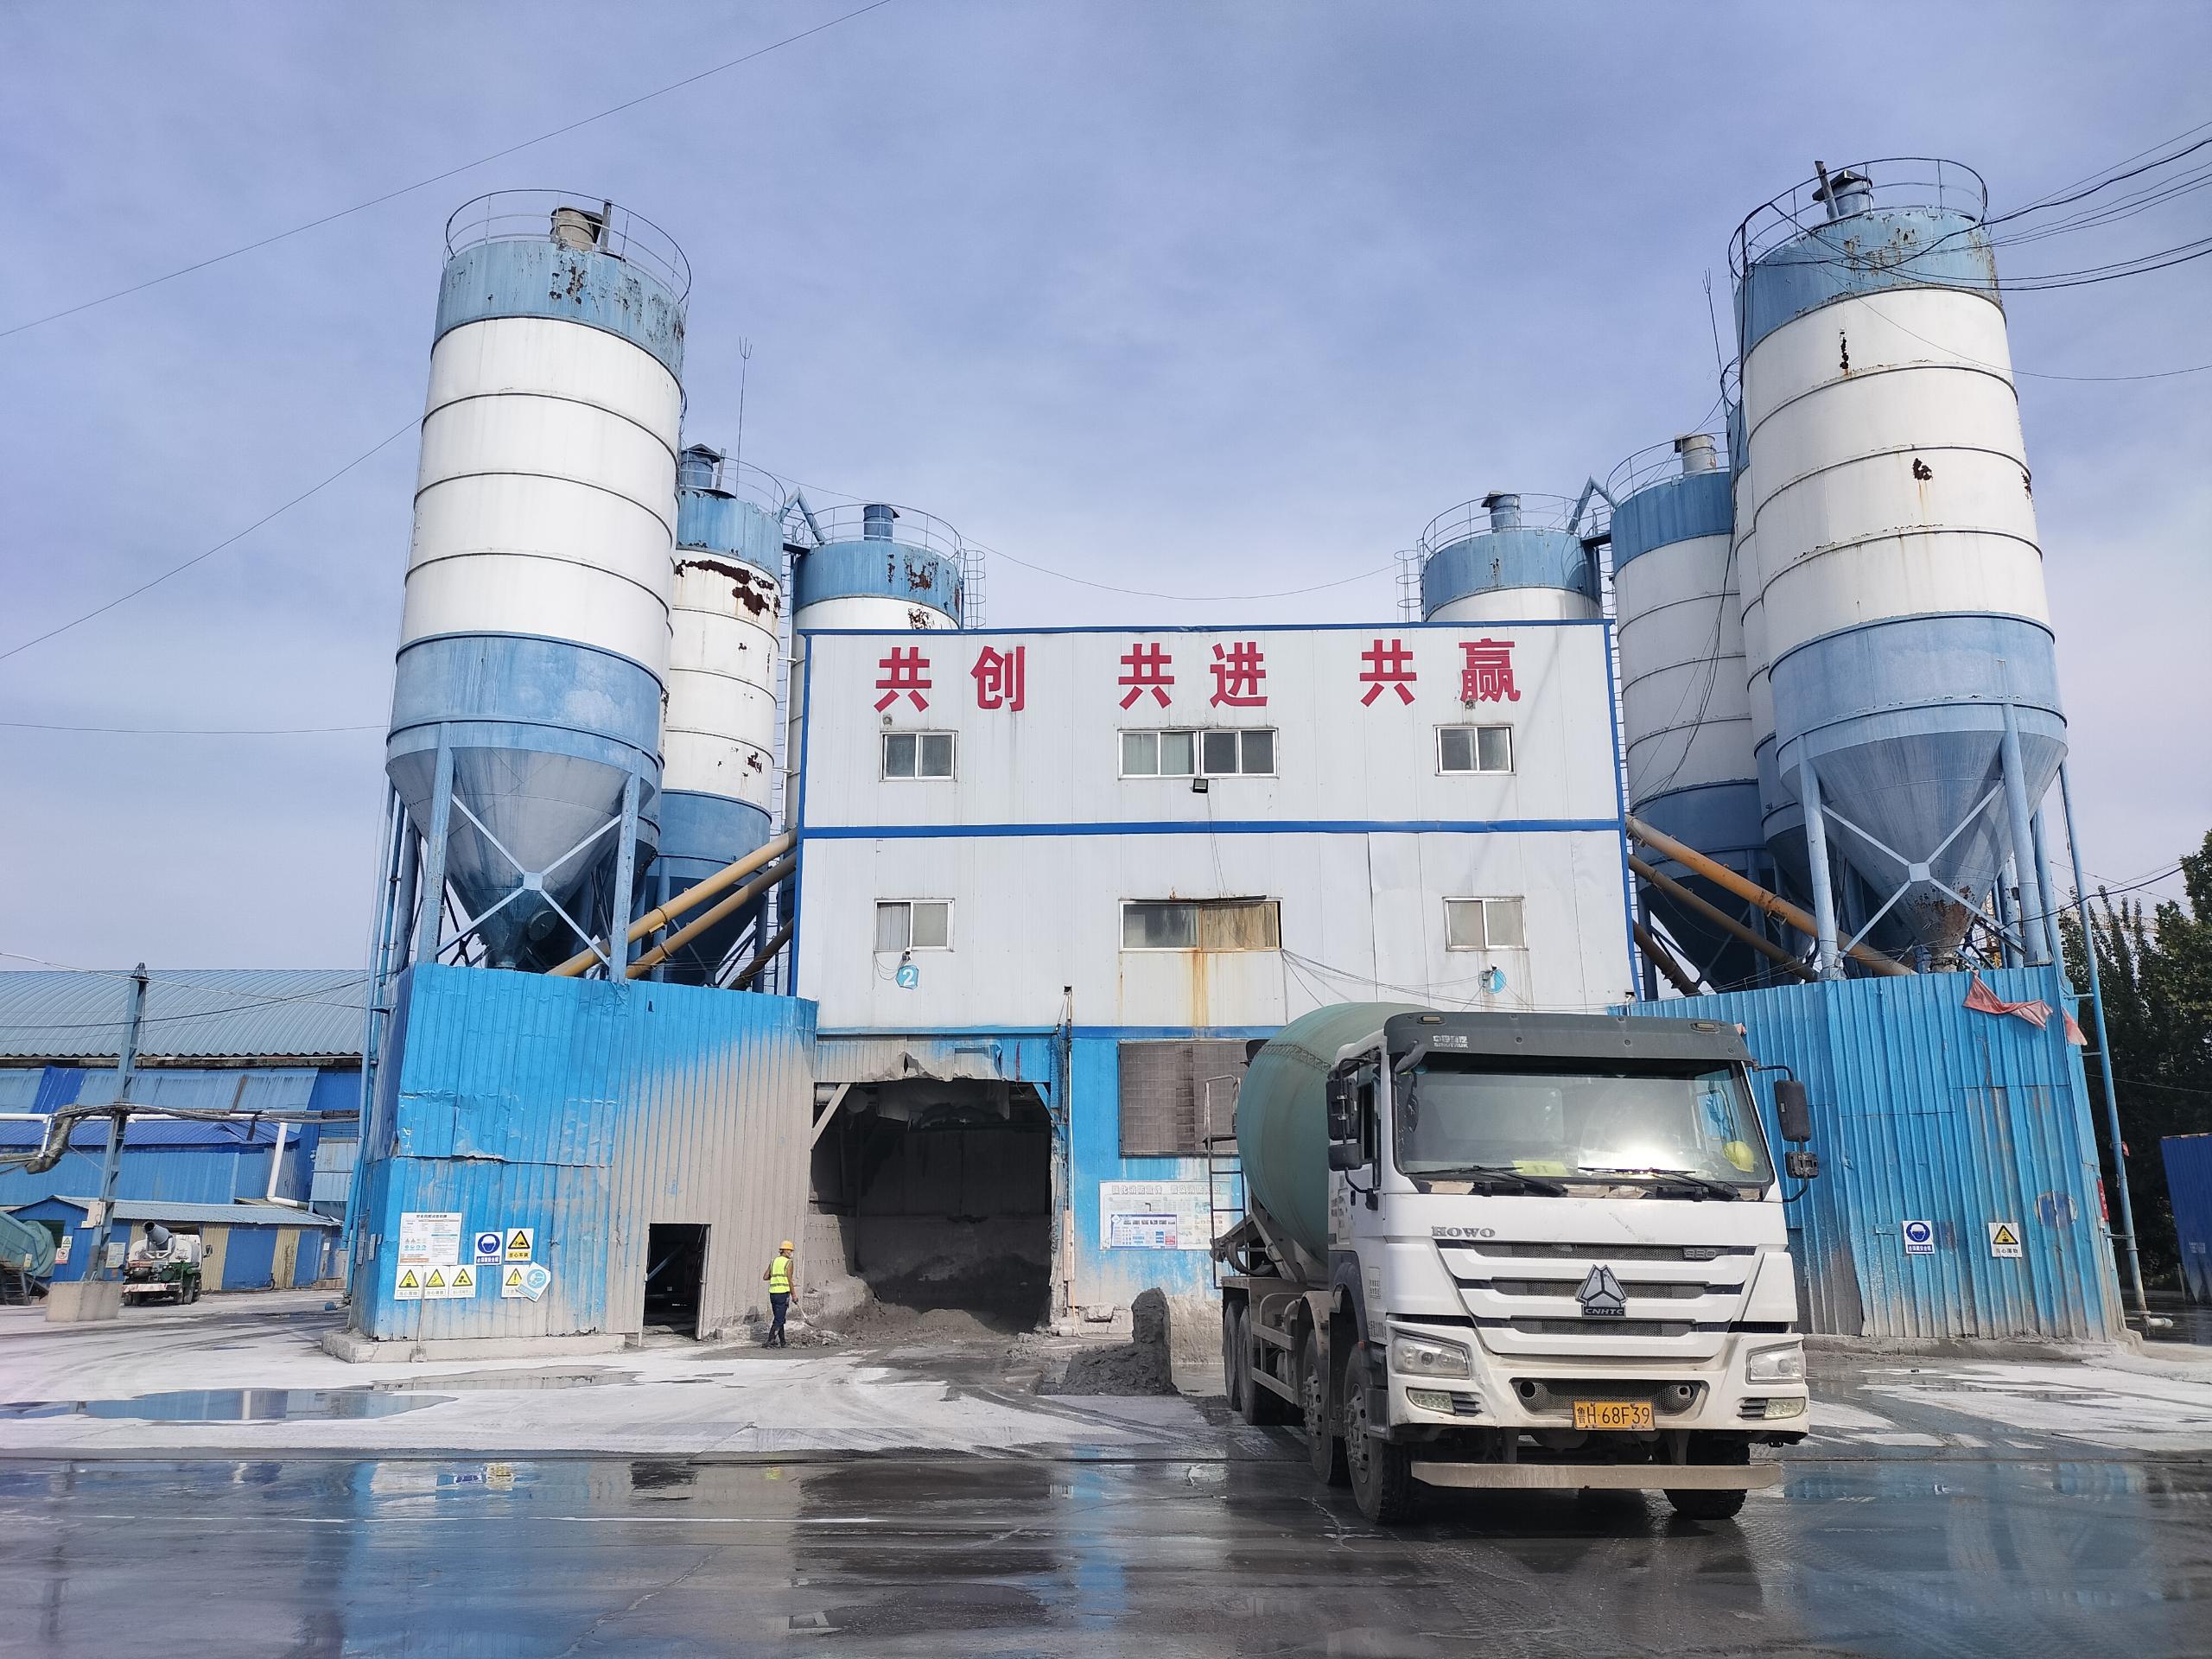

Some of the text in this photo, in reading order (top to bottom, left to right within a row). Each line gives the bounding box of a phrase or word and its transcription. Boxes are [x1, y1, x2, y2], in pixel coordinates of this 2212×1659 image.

[874, 637, 1522, 713] 共创 共进 共赢
[902, 969, 914, 986] 2
[1431, 1226, 1496, 1238] HOWO
